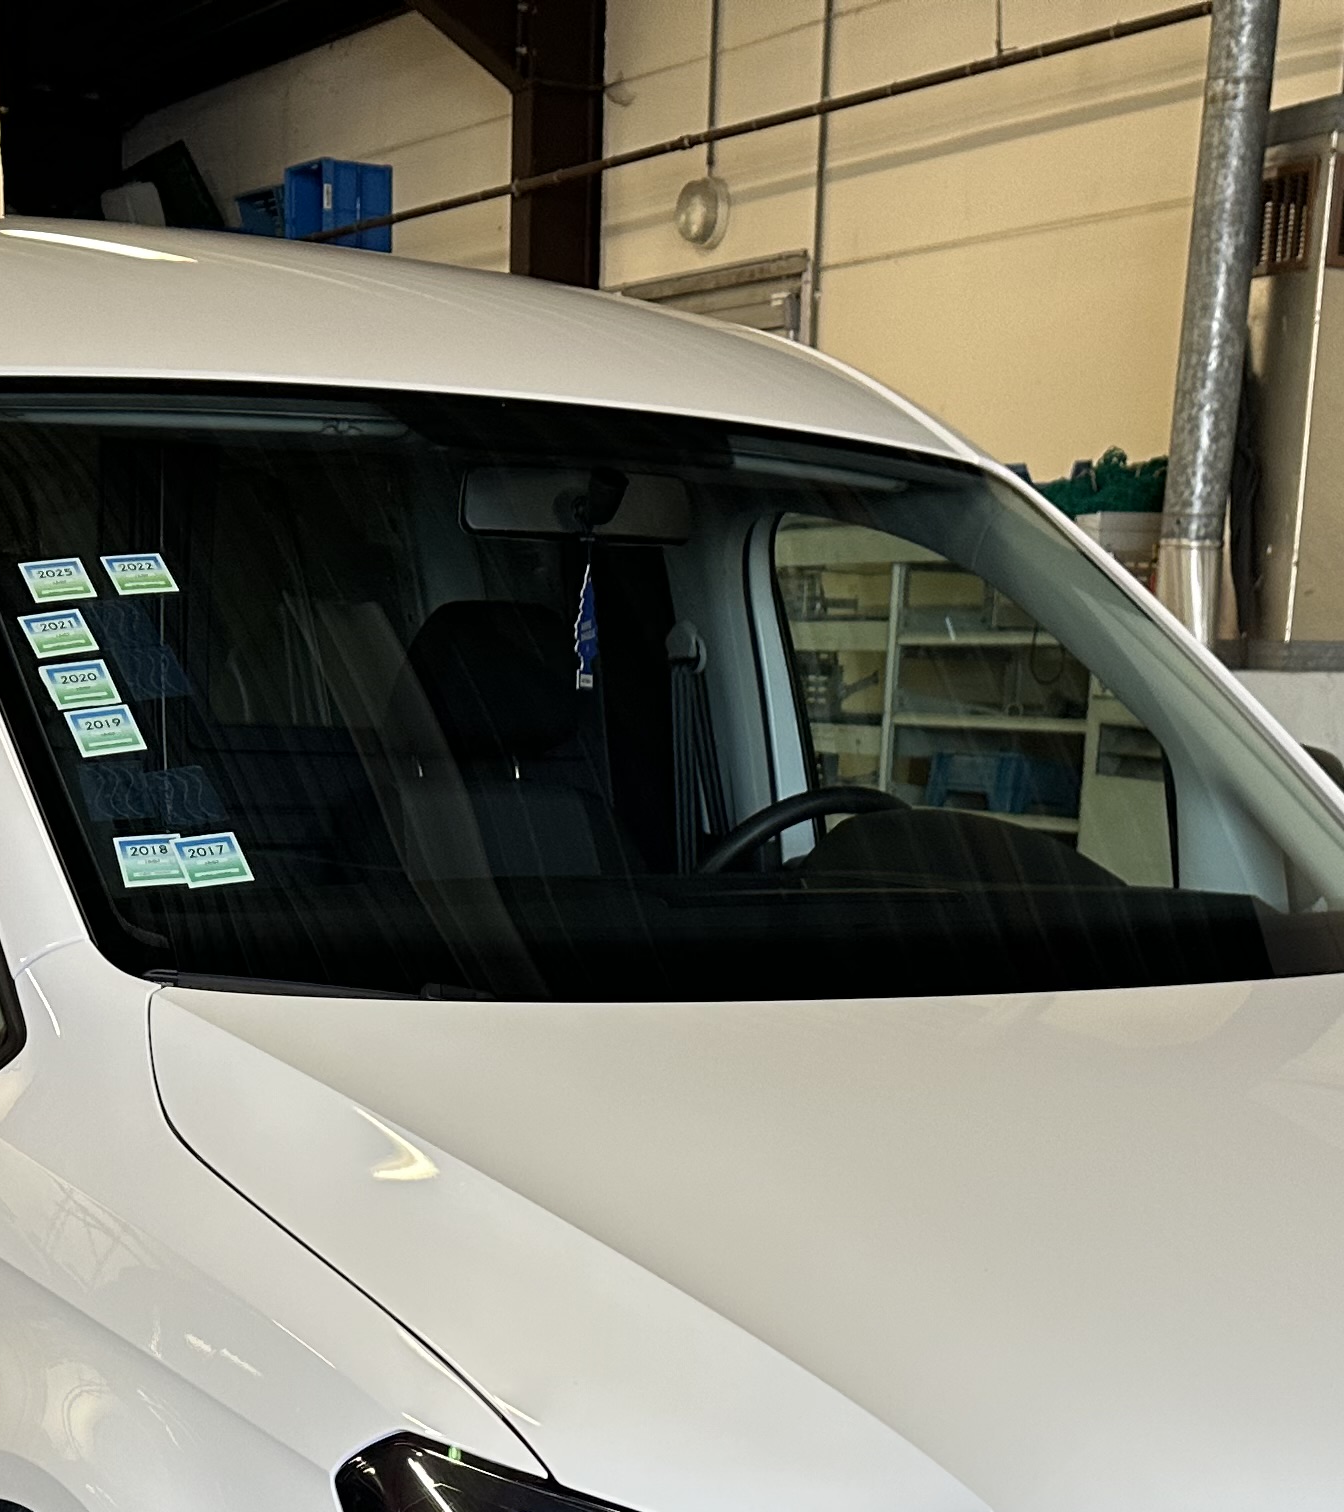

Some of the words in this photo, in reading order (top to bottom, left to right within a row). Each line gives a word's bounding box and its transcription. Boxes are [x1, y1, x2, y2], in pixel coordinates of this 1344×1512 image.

[38, 568, 74, 579] 2025
[120, 562, 154, 572] 2022
[40, 619, 75, 632] 2021
[60, 672, 97, 685] 2020
[85, 717, 121, 731] 2019
[130, 844, 168, 857] 2018
[187, 844, 224, 858] 2017
